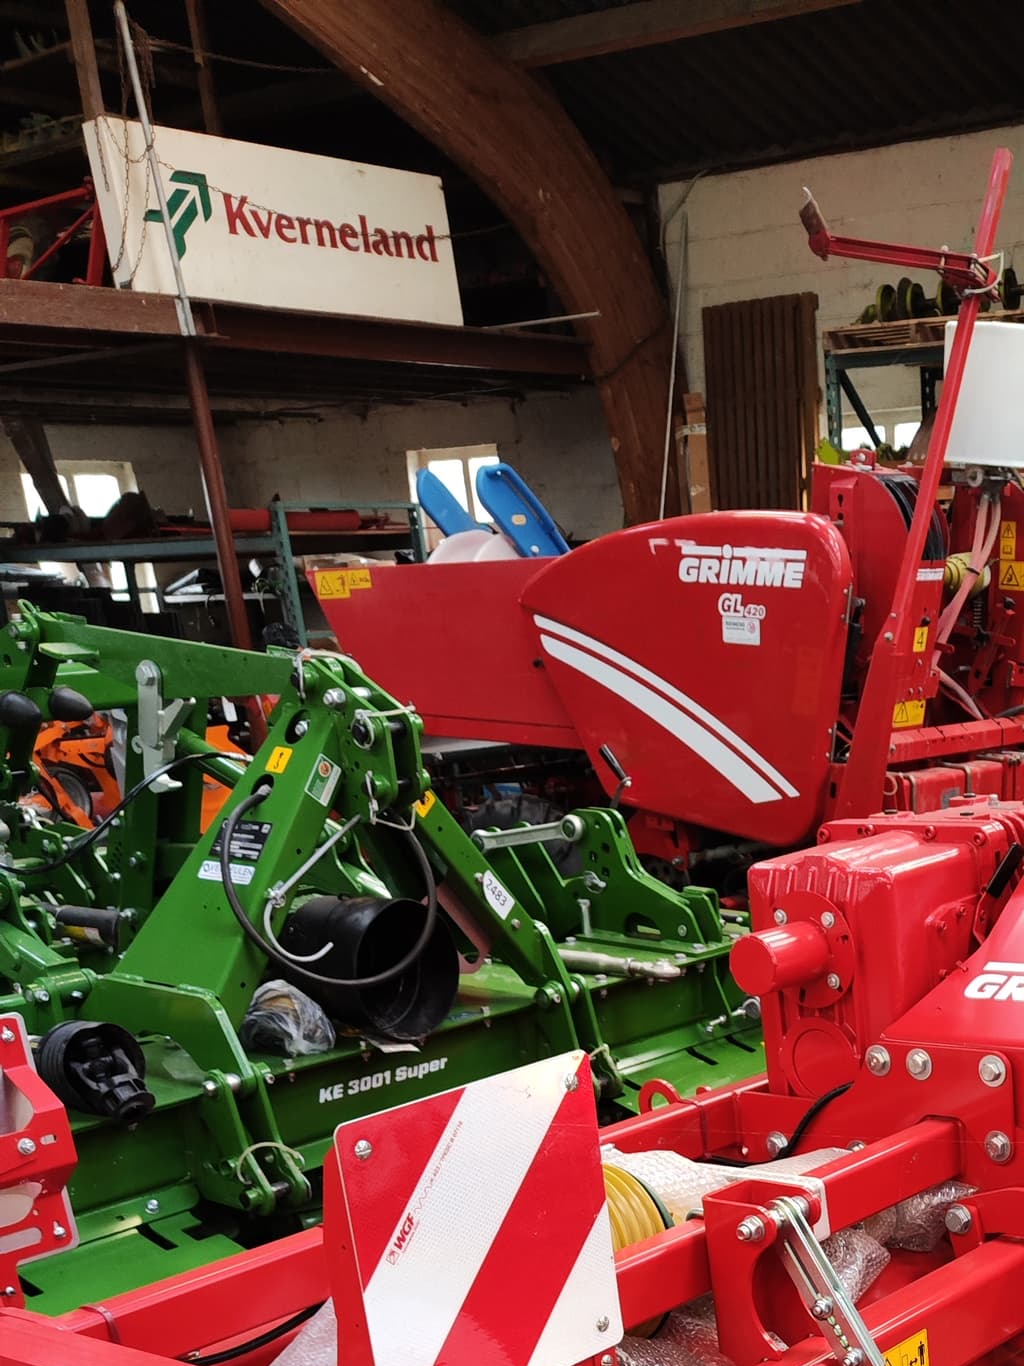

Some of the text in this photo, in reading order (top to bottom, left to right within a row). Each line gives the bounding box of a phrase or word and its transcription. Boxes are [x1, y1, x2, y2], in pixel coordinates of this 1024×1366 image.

[222, 192, 439, 263] Kverneland
[679, 547, 806, 588] GRIMME
[719, 593, 766, 618] GL 420
[916, 631, 924, 648] 4
[486, 879, 508, 906] 2483
[319, 1057, 448, 1103] KE 3001 Super
[393, 1211, 415, 1250] WGF
